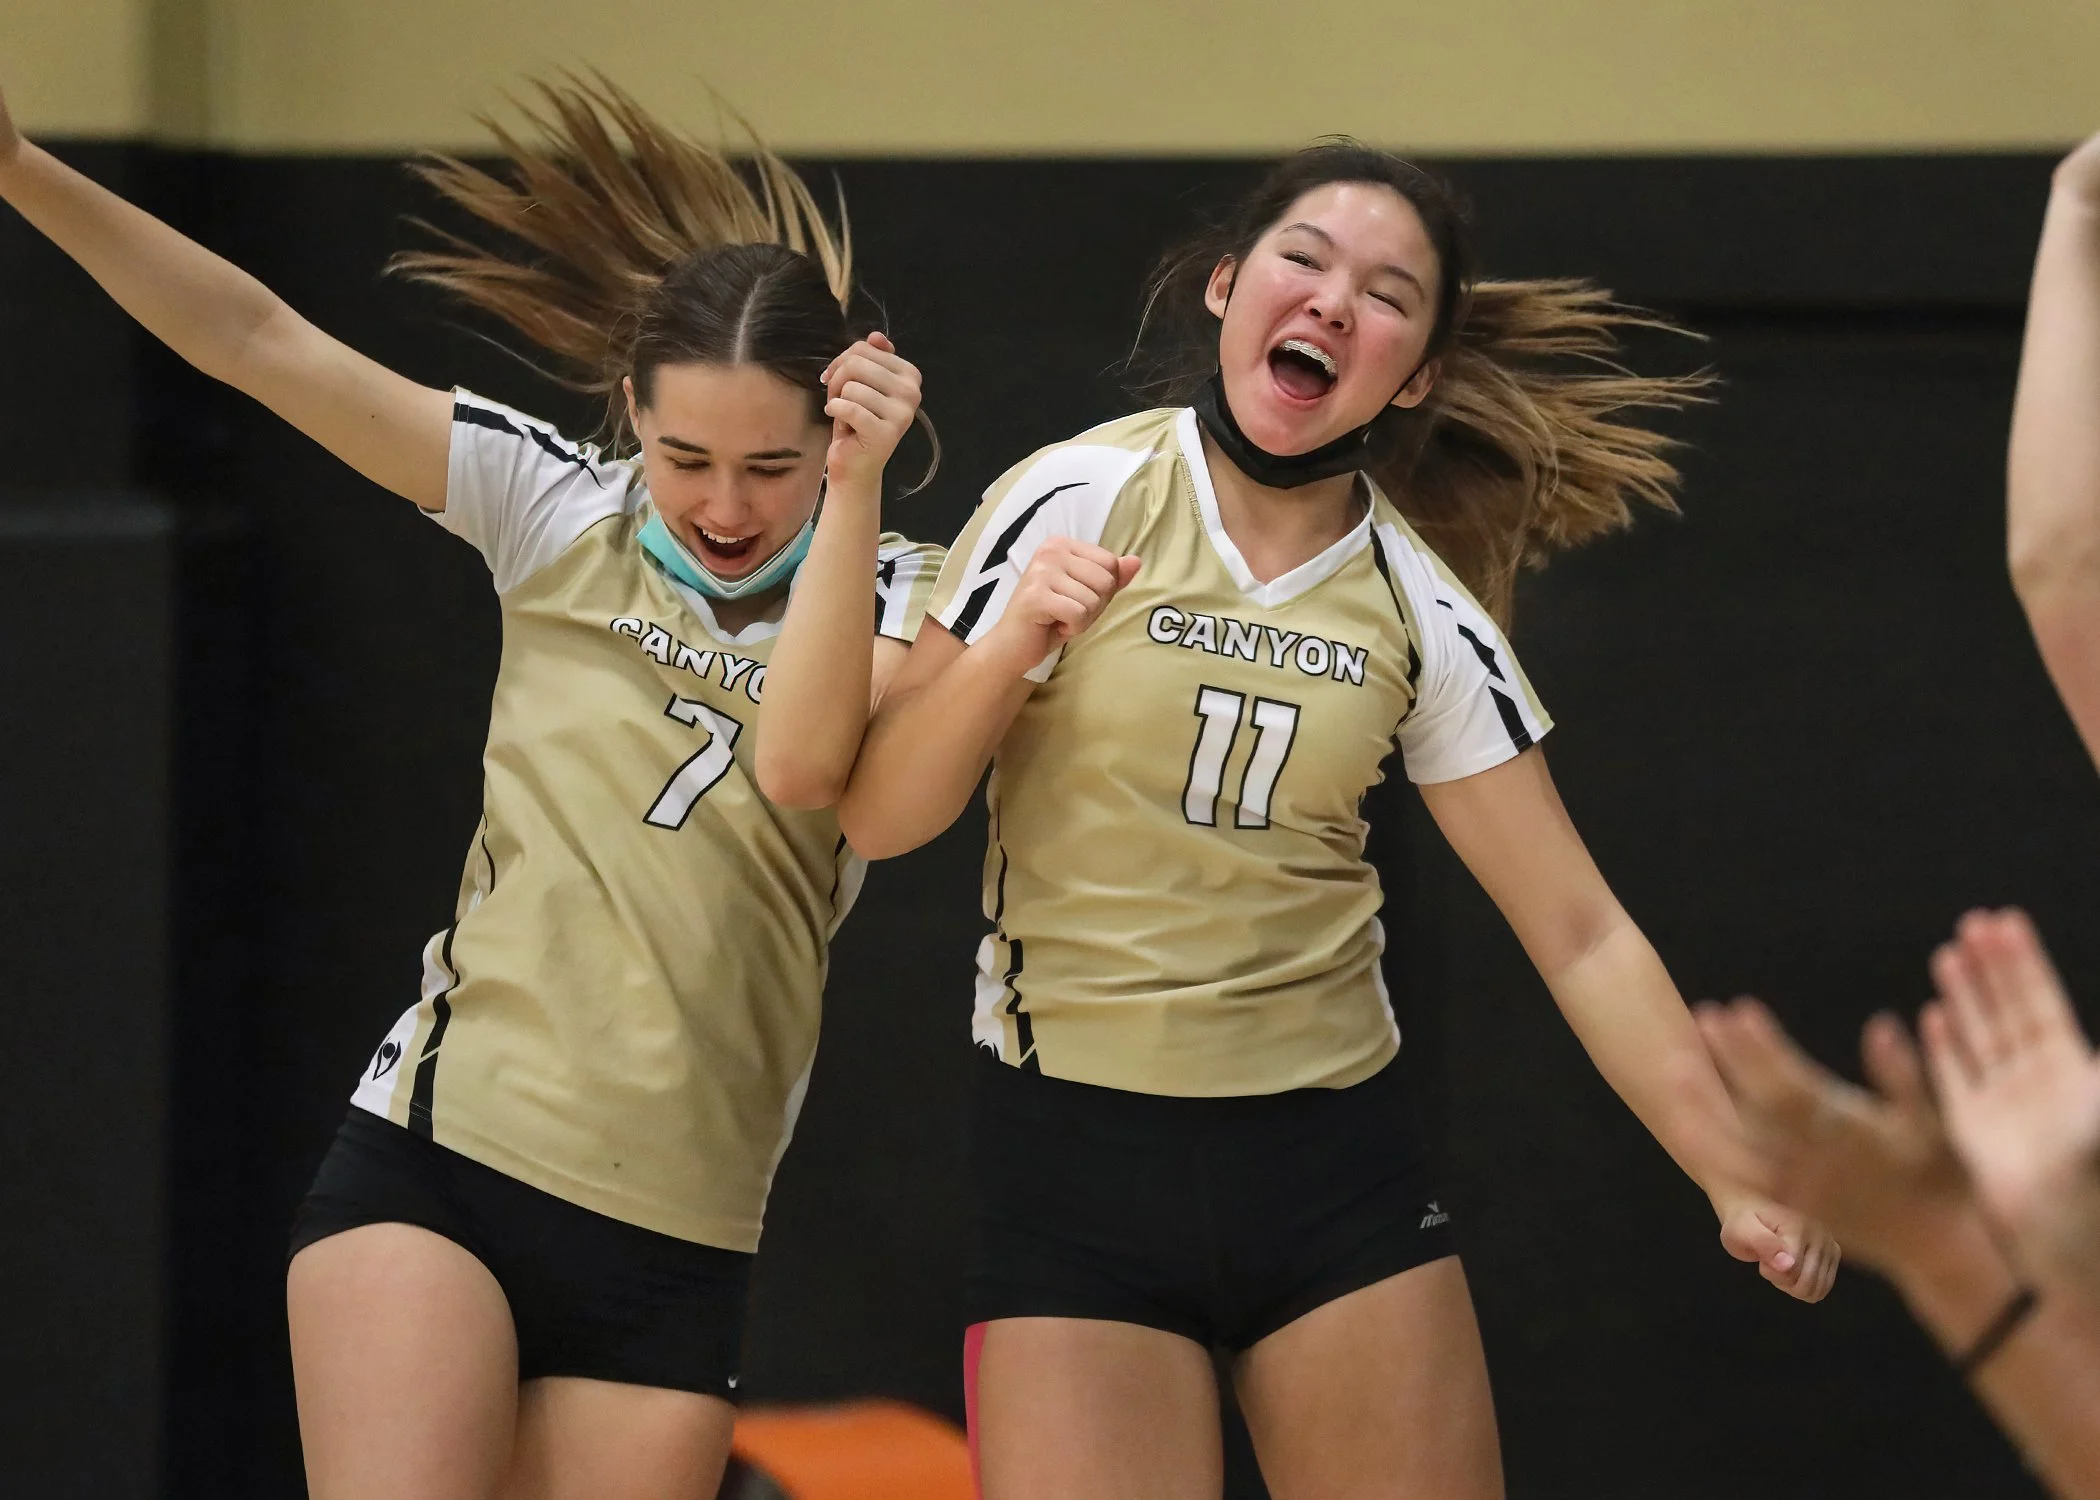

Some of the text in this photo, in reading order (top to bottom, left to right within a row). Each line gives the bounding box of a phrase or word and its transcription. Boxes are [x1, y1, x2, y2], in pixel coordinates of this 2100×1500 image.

[610, 618, 767, 705] CANYO
[1147, 605, 1369, 686] CANYON
[642, 693, 743, 831] 7
[1181, 684, 1301, 830] 11
